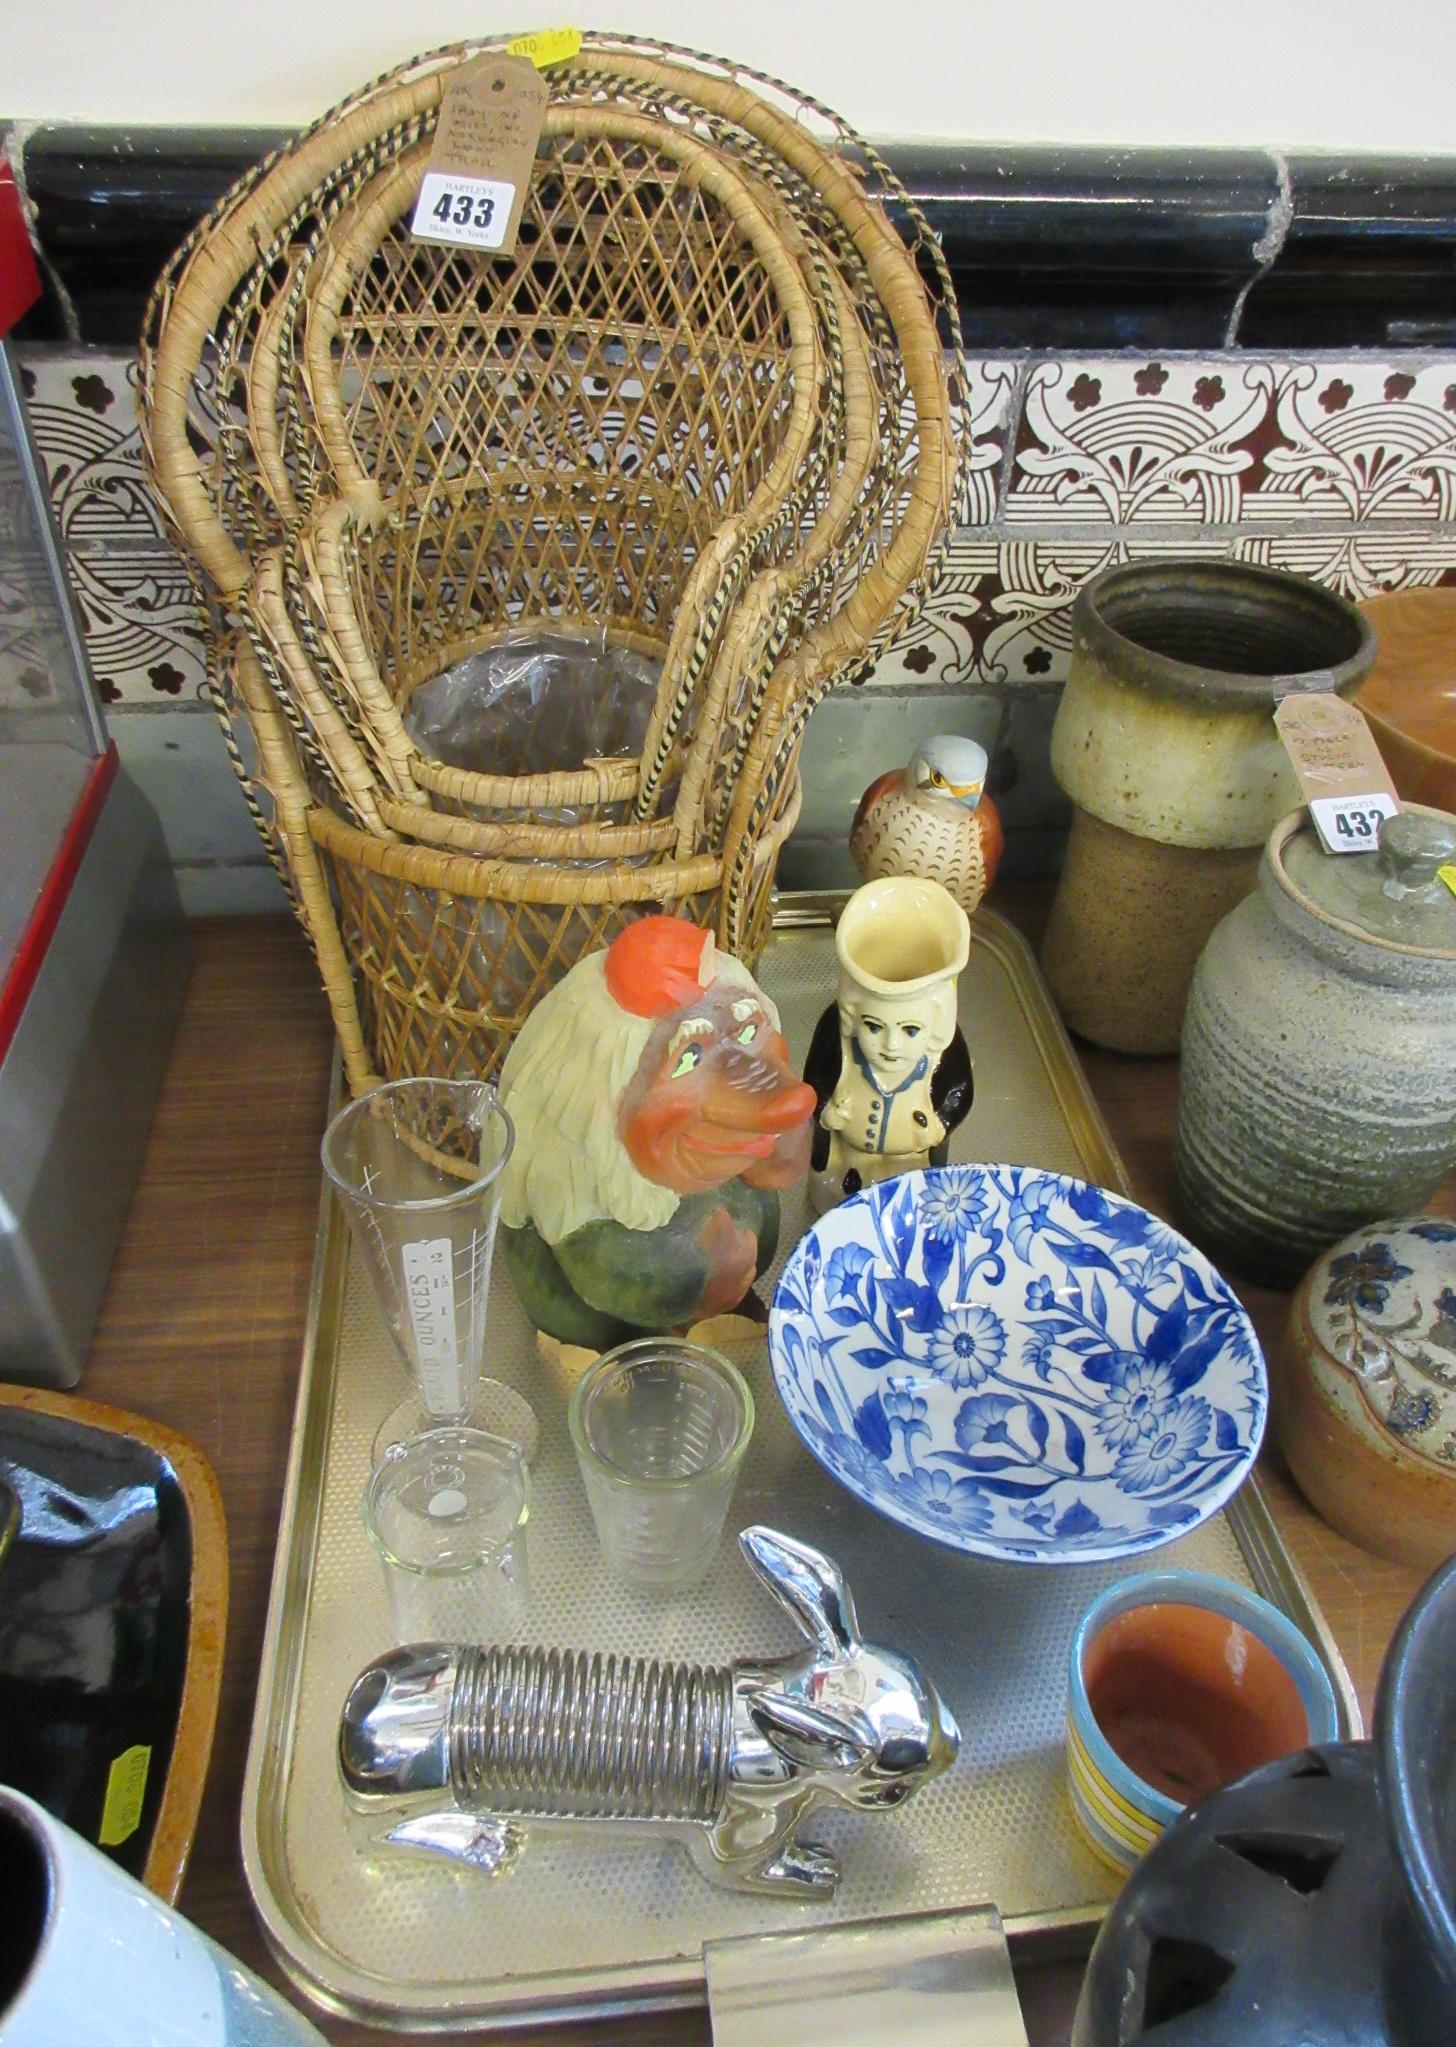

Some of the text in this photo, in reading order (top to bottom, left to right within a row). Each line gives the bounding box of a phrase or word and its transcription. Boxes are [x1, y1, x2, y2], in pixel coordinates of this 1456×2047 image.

[444, 182, 495, 196] HARTLEYS
[432, 193, 496, 228] 433
[409, 1273, 436, 1347] OUNCES
